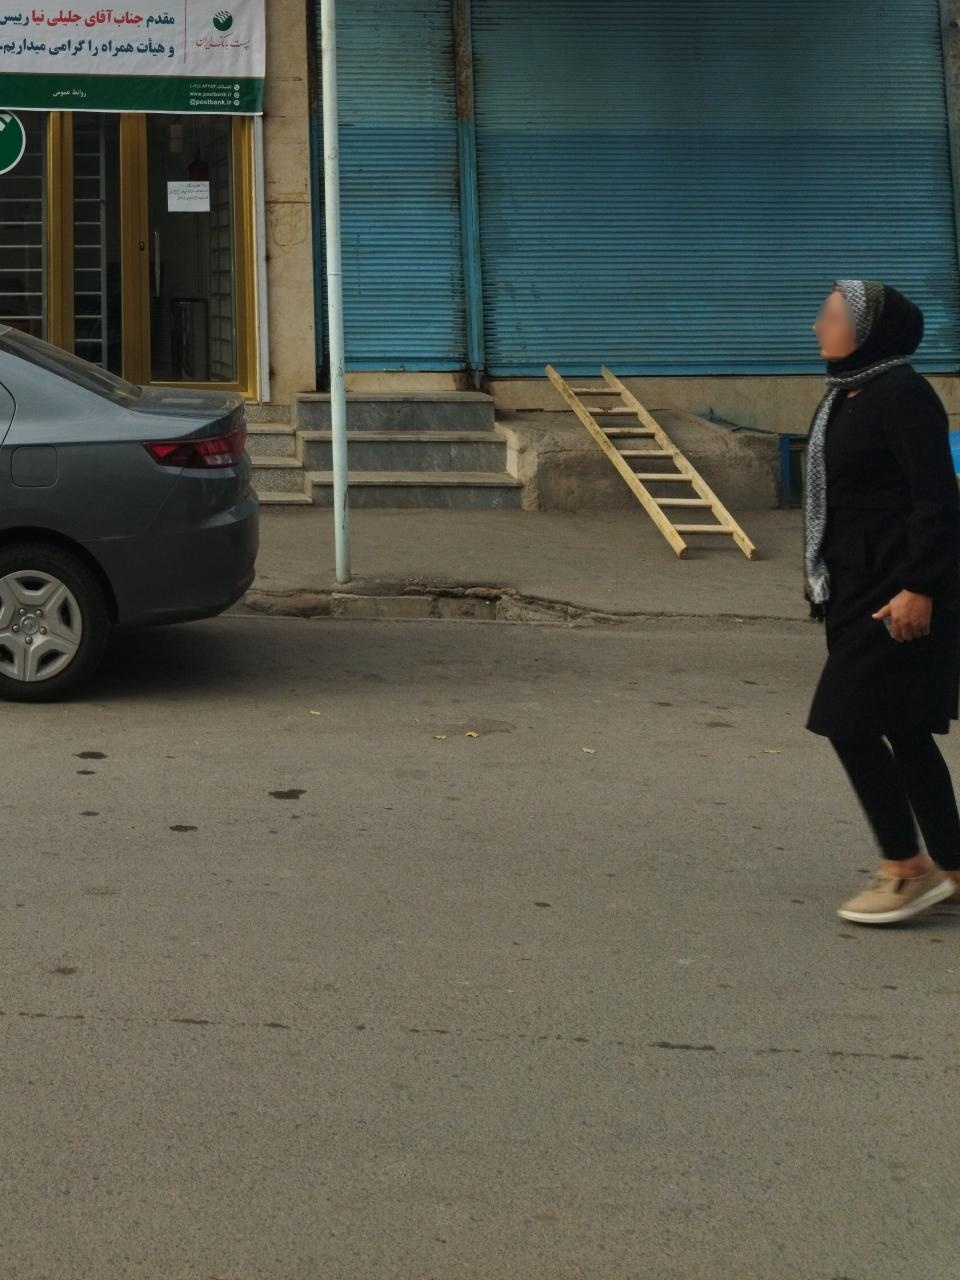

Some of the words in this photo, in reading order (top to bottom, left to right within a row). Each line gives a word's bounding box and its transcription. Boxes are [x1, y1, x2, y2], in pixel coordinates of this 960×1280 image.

[31, 9, 46, 26] نیا
[46, 9, 83, 27] جلیلی
[84, 8, 113, 28] آقای
[114, 11, 144, 28] جناب
[145, 12, 176, 28] مقدم
[48, 39, 86, 57] گرامی
[88, 38, 100, 57] را
[100, 39, 135, 56] همراه
[167, 45, 176, 58] و
